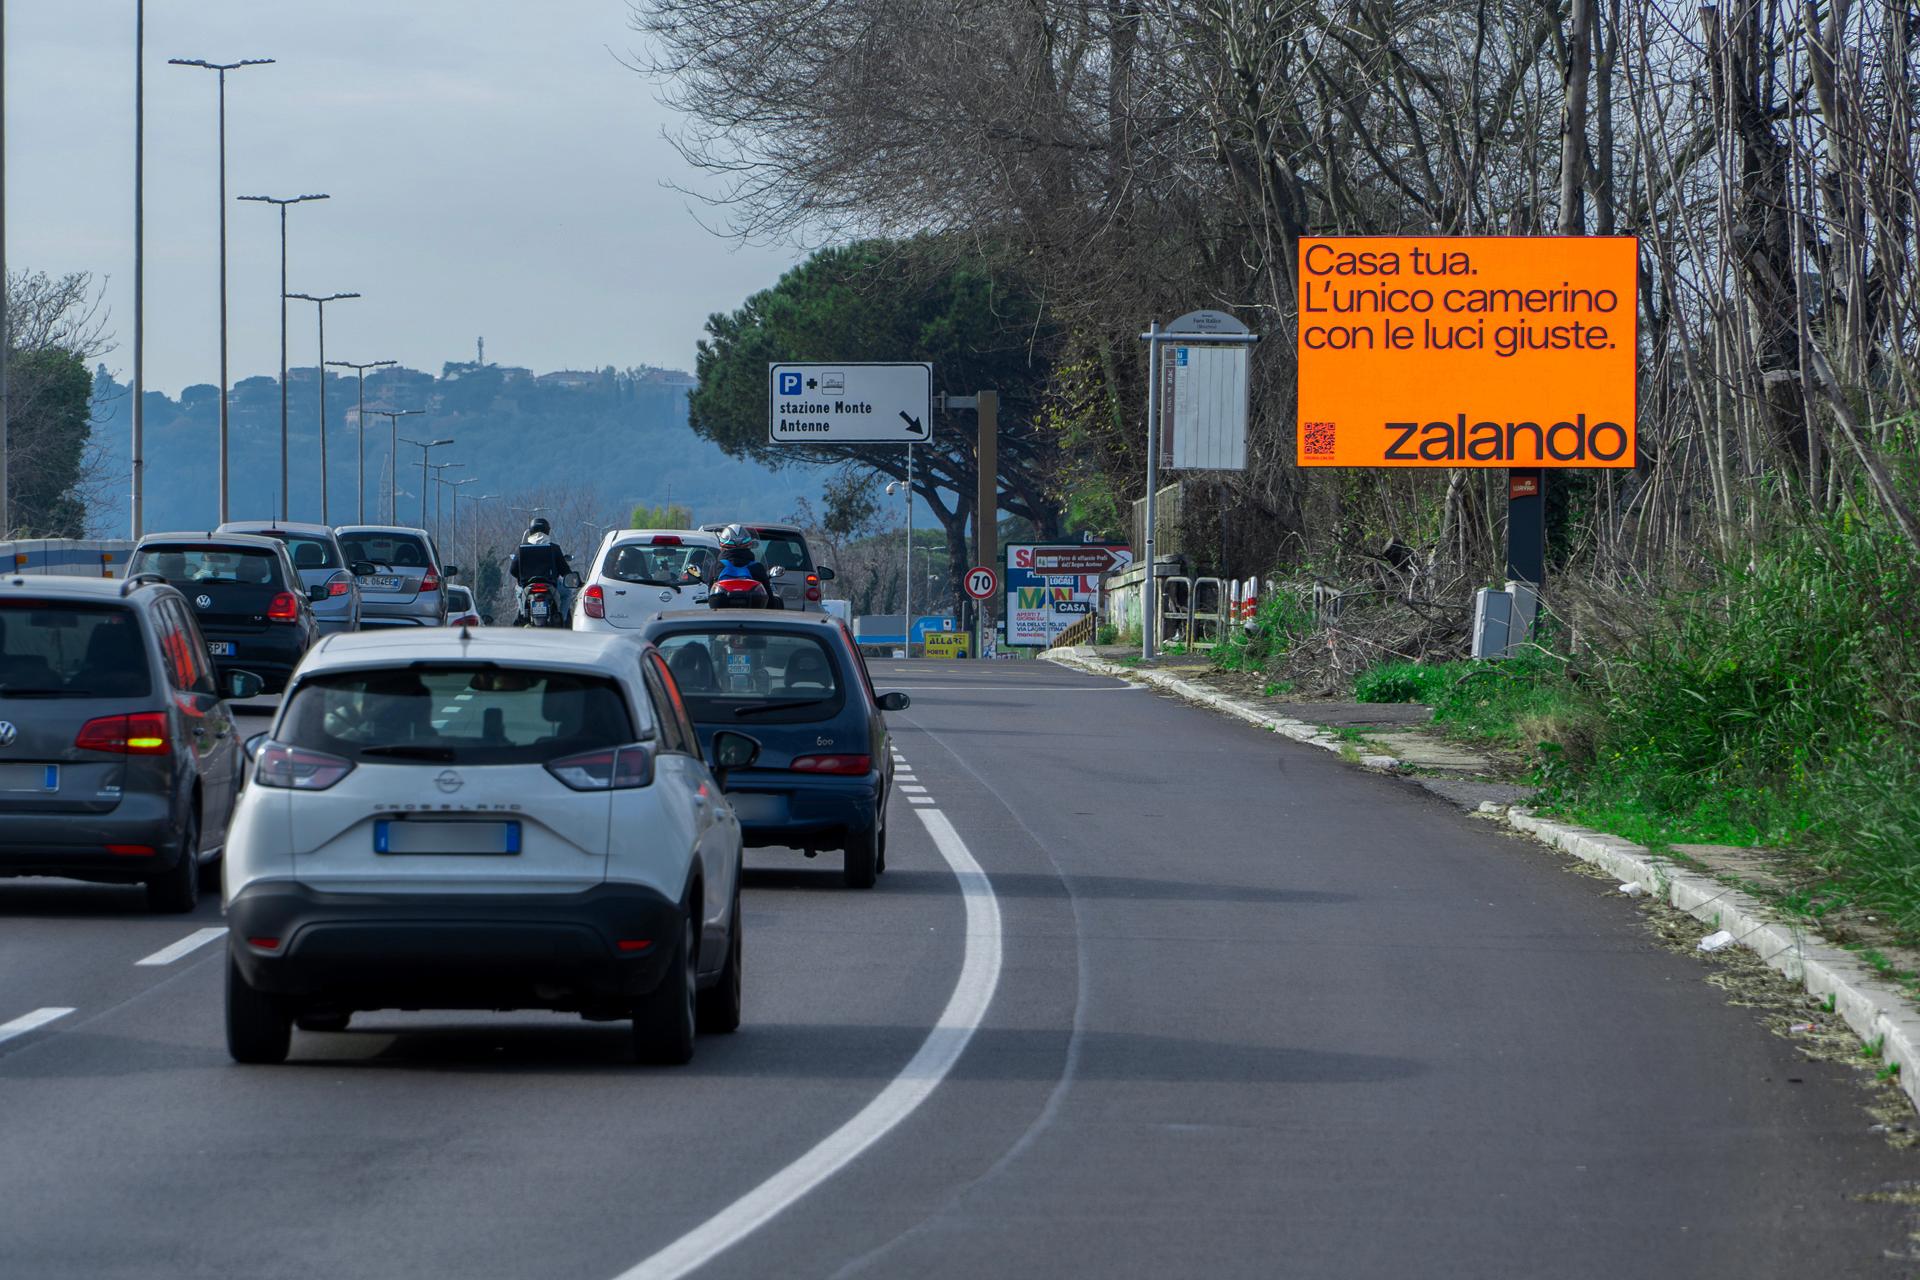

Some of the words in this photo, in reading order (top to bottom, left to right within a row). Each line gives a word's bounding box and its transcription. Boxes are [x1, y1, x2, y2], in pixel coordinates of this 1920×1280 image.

[1305, 244, 1400, 276] Casa
[1409, 247, 1478, 276] tua.
[1305, 280, 1434, 313] L'unico
[1443, 281, 1618, 313] camerino
[1304, 326, 1374, 350] con
[1385, 318, 1414, 350] le
[1424, 318, 1485, 350] luci
[1494, 318, 1616, 357] giuste.
[784, 375, 798, 393] P
[779, 401, 830, 414] stazione
[835, 401, 872, 414] Monte
[779, 418, 830, 432] Antenne
[1384, 413, 1628, 461] zalando
[973, 575, 991, 591] 70
[1059, 603, 1086, 612] CASA
[816, 736, 834, 746] 600
